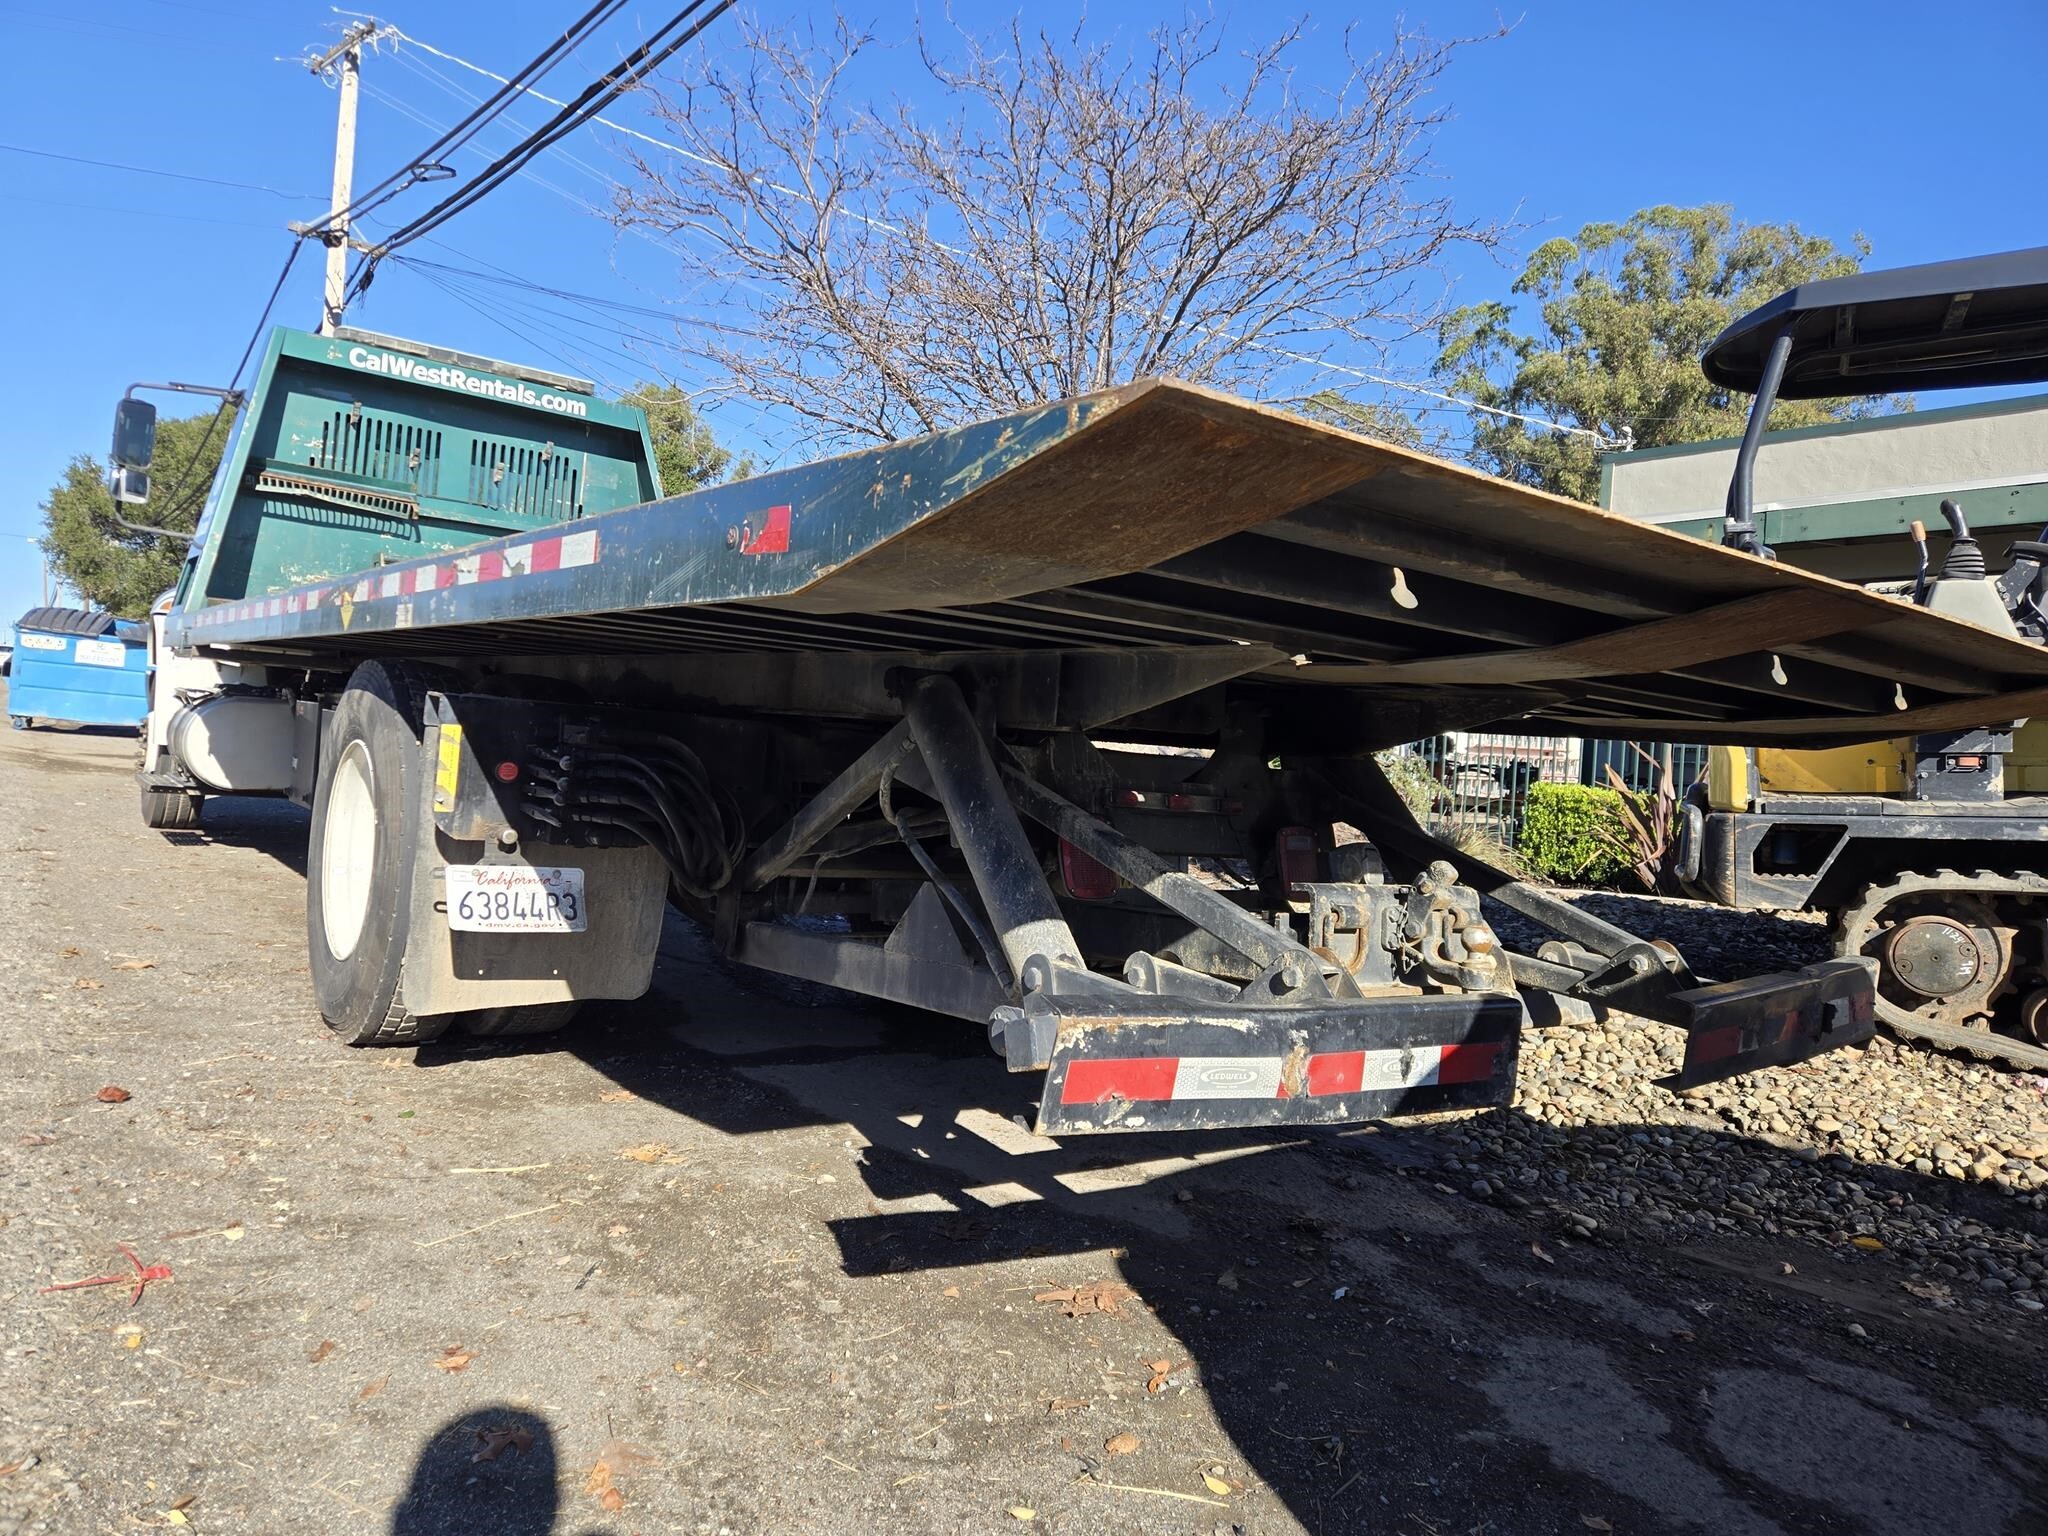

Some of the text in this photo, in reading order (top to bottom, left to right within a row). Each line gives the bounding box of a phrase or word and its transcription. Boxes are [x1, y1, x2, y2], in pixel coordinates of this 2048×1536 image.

[349, 346, 587, 417] CalWestRentals.com
[475, 870, 559, 891] California
[458, 890, 578, 921] 63844R3
[1209, 1072, 1249, 1080] LEDWELL
